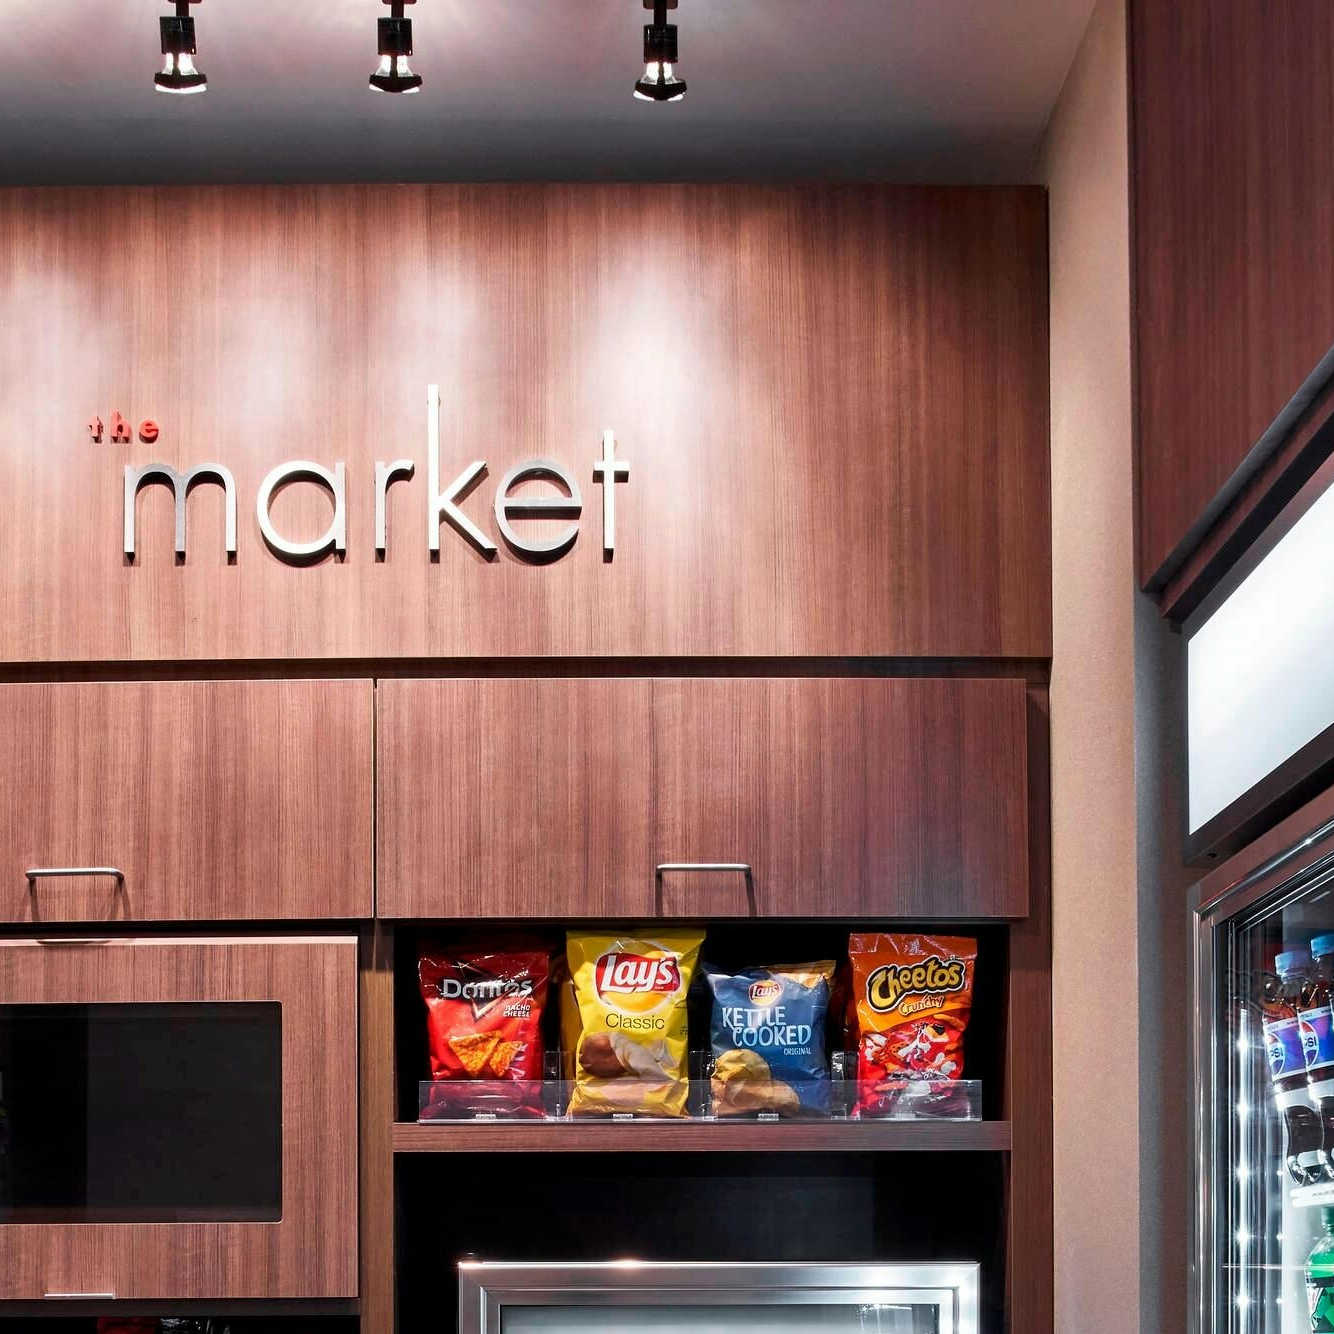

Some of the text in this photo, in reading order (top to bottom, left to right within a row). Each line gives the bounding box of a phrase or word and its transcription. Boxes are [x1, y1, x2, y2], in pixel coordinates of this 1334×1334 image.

[88, 410, 159, 443] the
[123, 383, 631, 560] market
[599, 954, 675, 993] Lay's
[868, 956, 965, 1010] Cheetos
[441, 978, 533, 999] Doritos
[752, 983, 779, 999] Lay's
[503, 1010, 531, 1018] CHEESE
[898, 994, 945, 1016] Crunchy
[605, 1012, 665, 1030] Classic
[722, 1006, 787, 1030] KETTLE
[732, 1025, 812, 1047] COOKED
[783, 1047, 812, 1056] ORIGINAL
